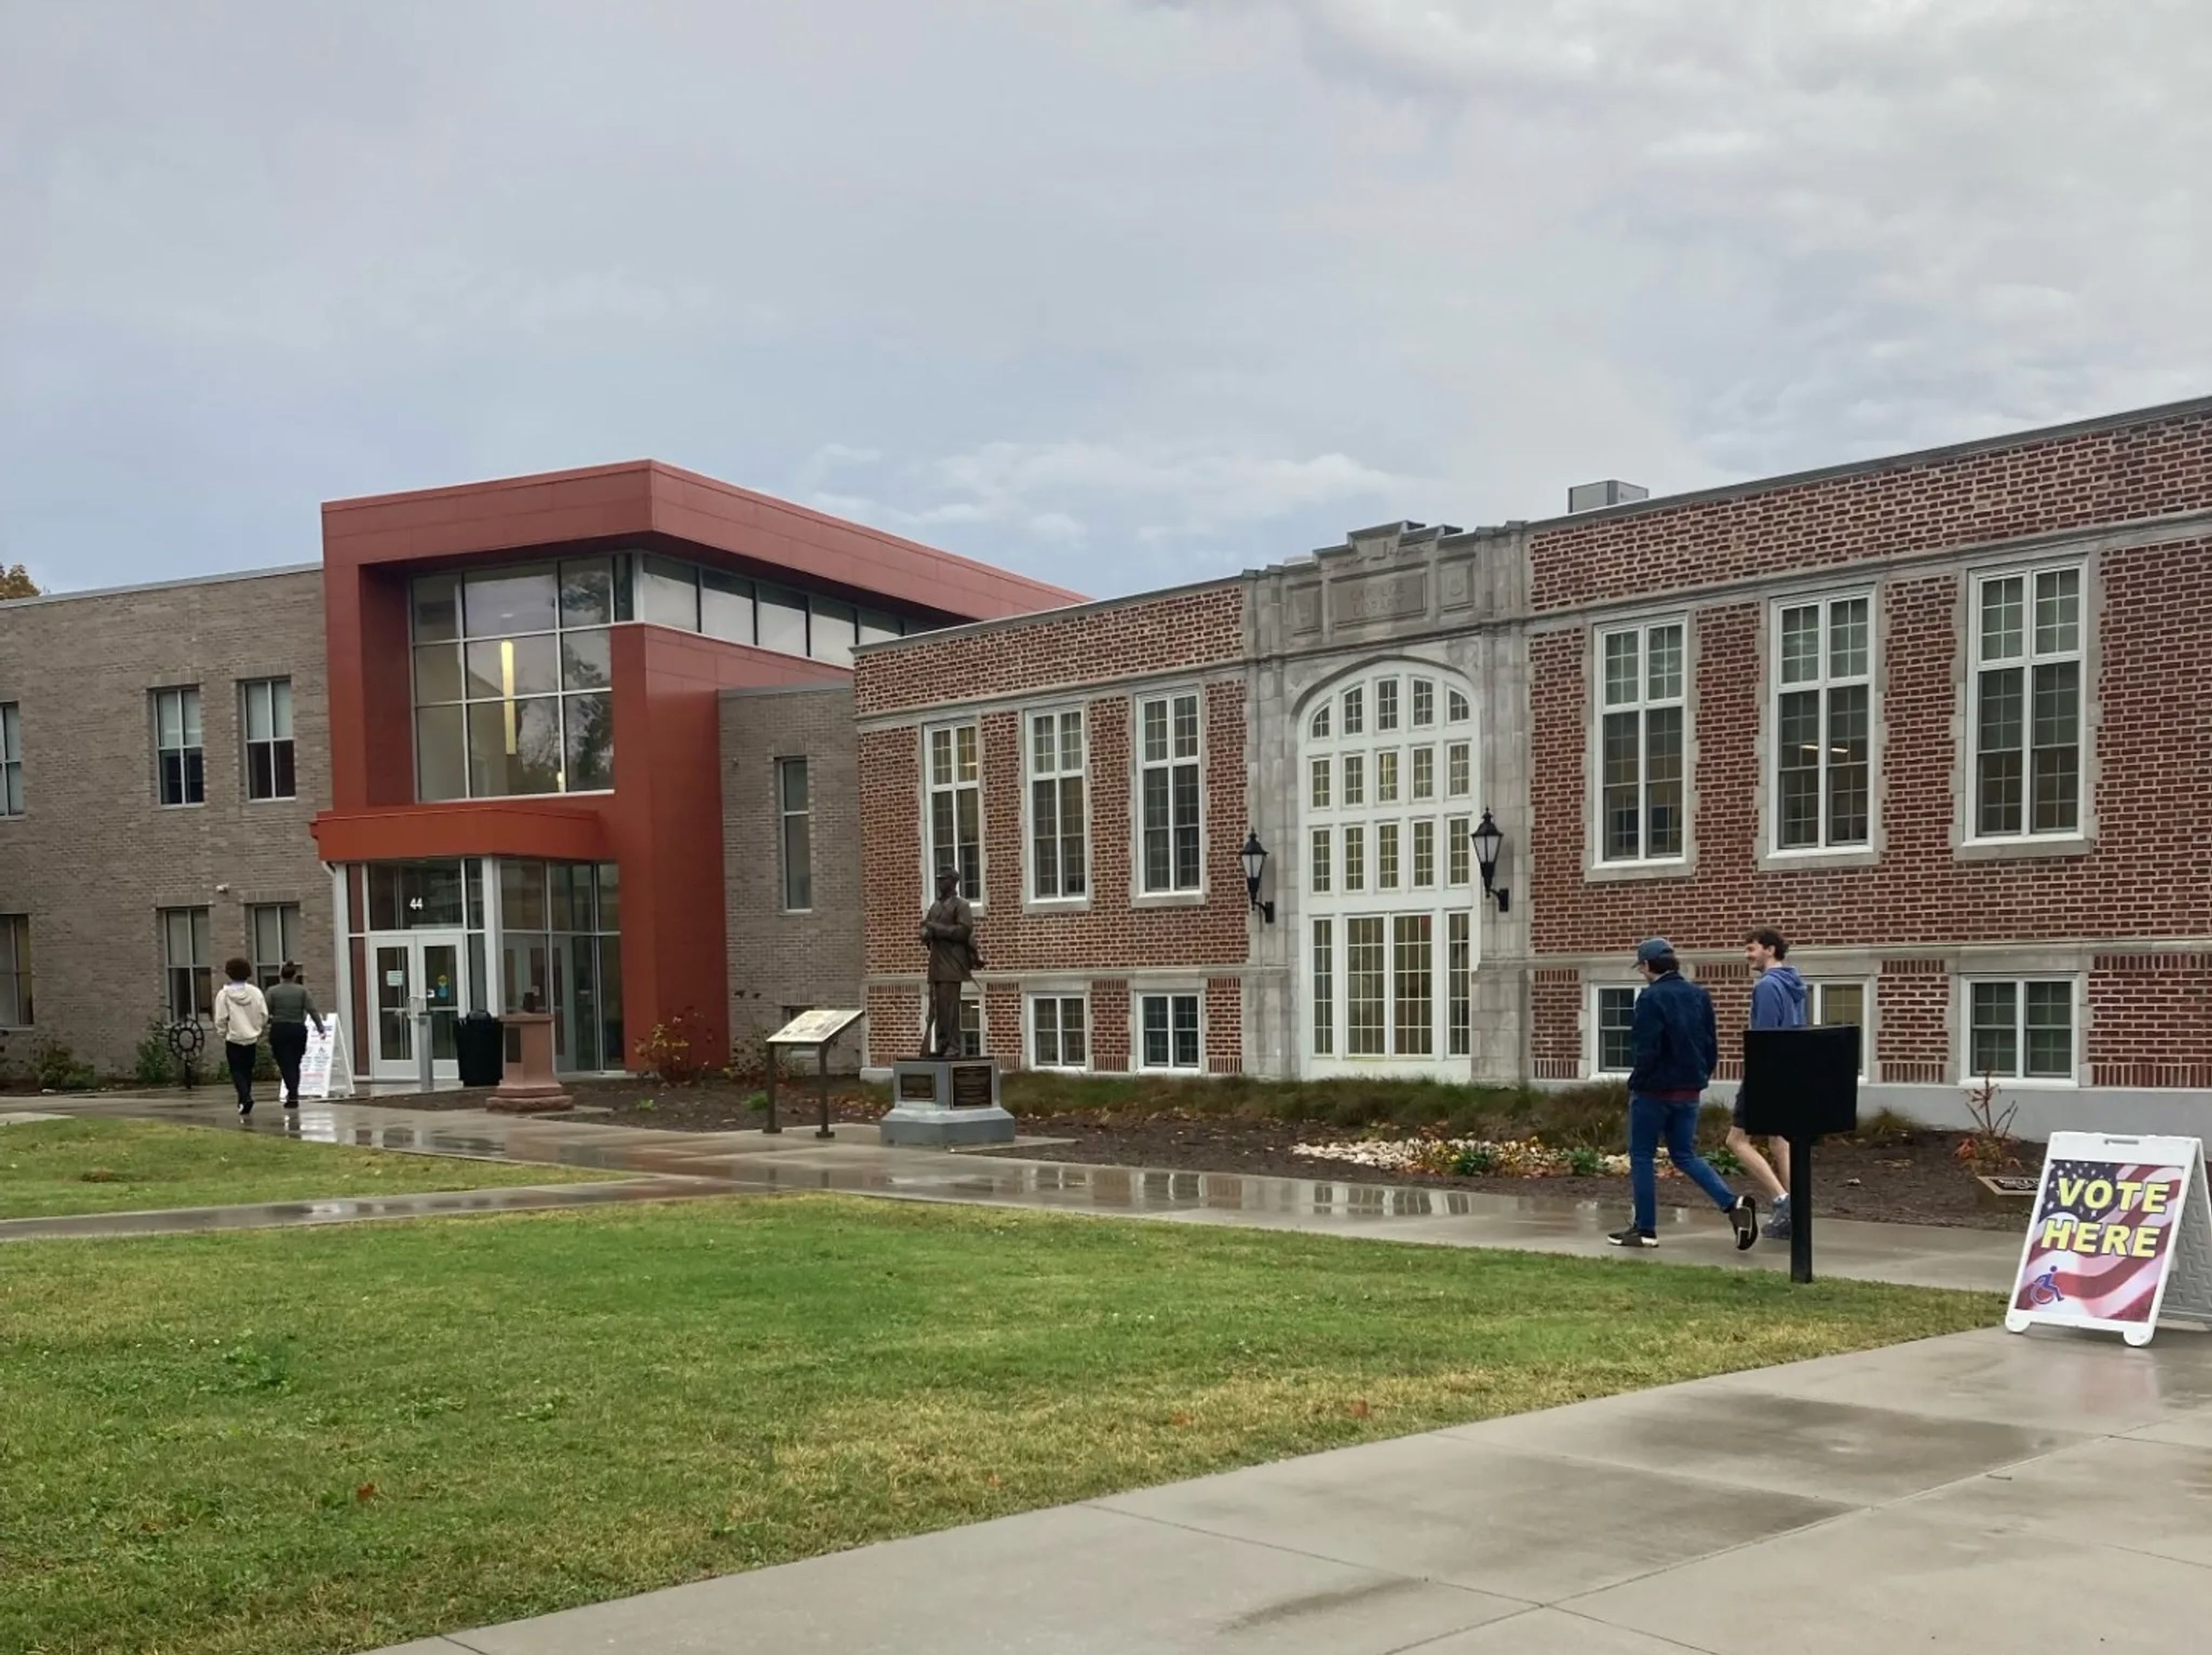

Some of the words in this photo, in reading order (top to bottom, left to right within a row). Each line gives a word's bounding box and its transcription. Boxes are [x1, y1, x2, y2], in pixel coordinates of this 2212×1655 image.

[410, 897, 423, 910] 44
[2058, 1177, 2171, 1214] VOTE
[2040, 1218, 2161, 1258] HERE
